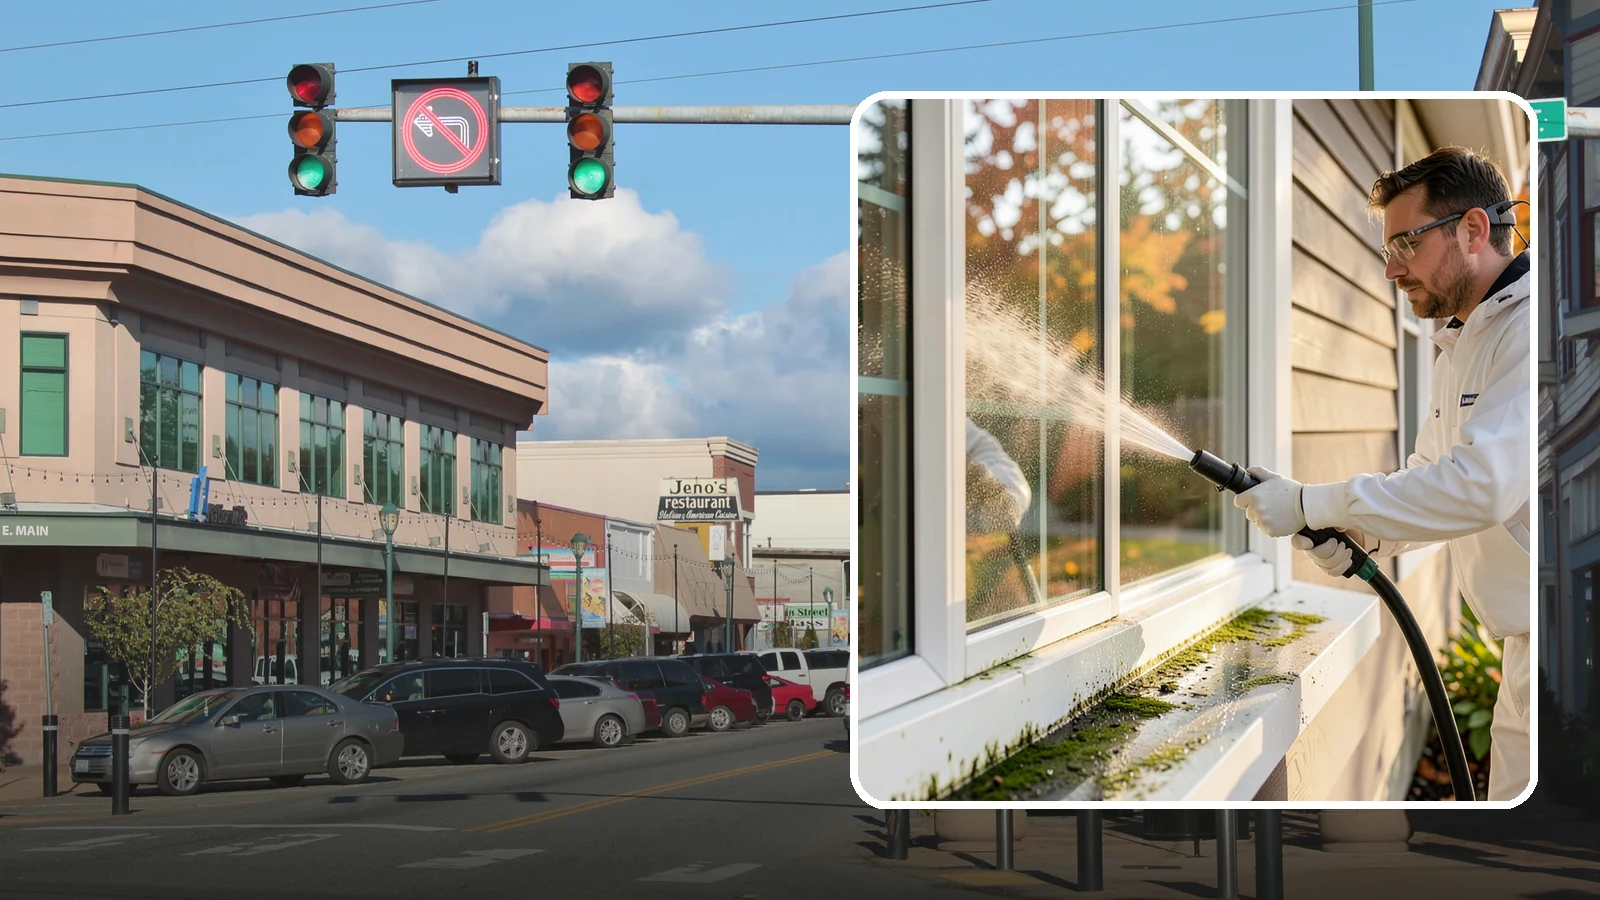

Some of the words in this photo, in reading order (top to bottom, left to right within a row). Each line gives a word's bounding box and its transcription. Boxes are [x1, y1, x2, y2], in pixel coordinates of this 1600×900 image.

[670, 480, 728, 494] Jeno's
[665, 496, 731, 509] restaurant
[686, 510, 714, 520] American
[715, 509, 738, 520] Cuisine
[2, 525, 13, 536] E.
[15, 525, 49, 536] MAIN
[798, 607, 828, 616] Street
